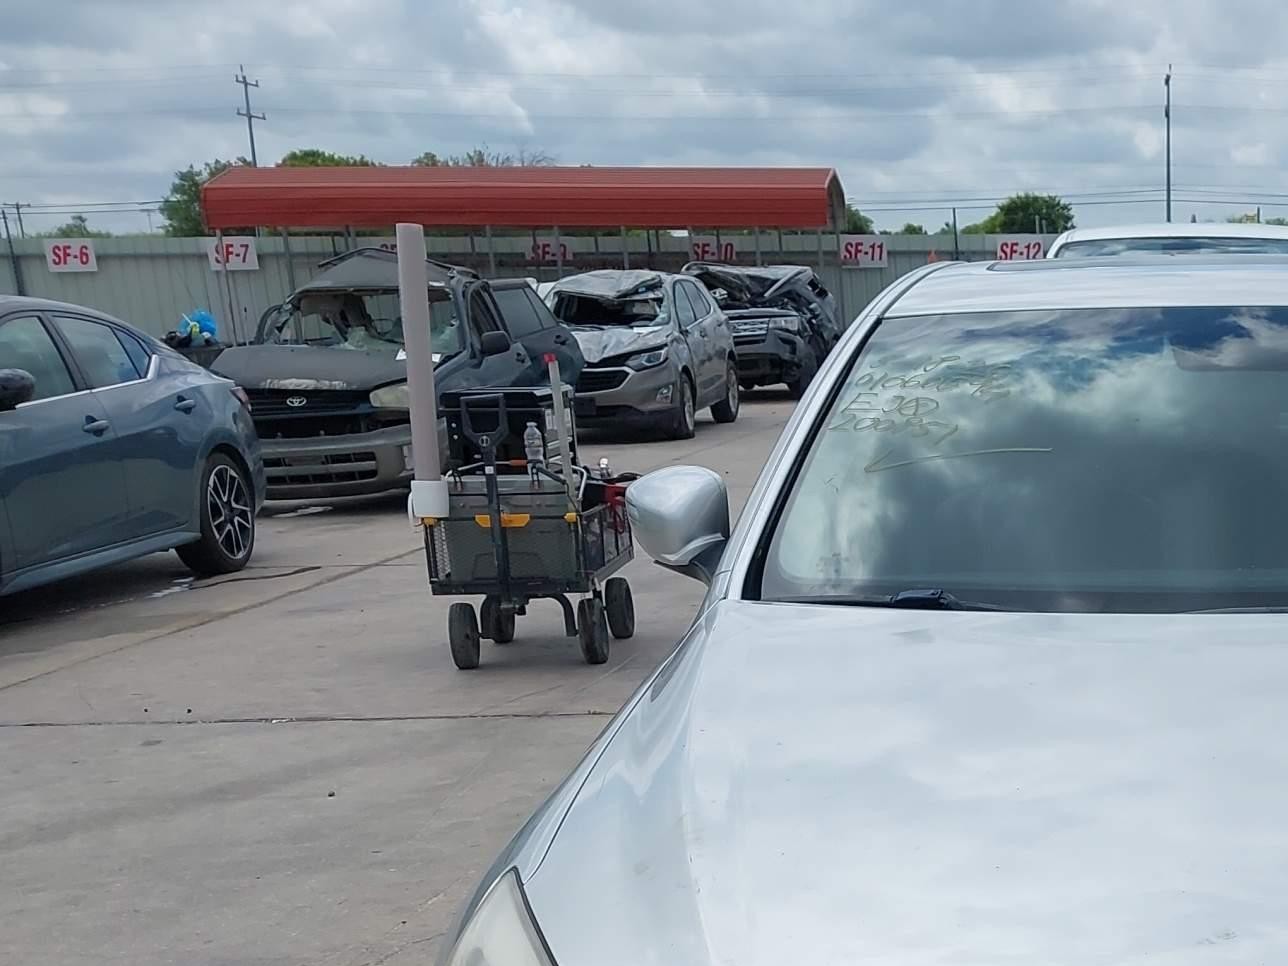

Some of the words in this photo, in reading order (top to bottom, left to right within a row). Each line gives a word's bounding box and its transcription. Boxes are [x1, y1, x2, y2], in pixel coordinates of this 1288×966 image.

[52, 245, 89, 266] SF-6
[214, 243, 250, 265] SF-7
[842, 241, 885, 261] SF-11
[999, 241, 1042, 260] SF-12
